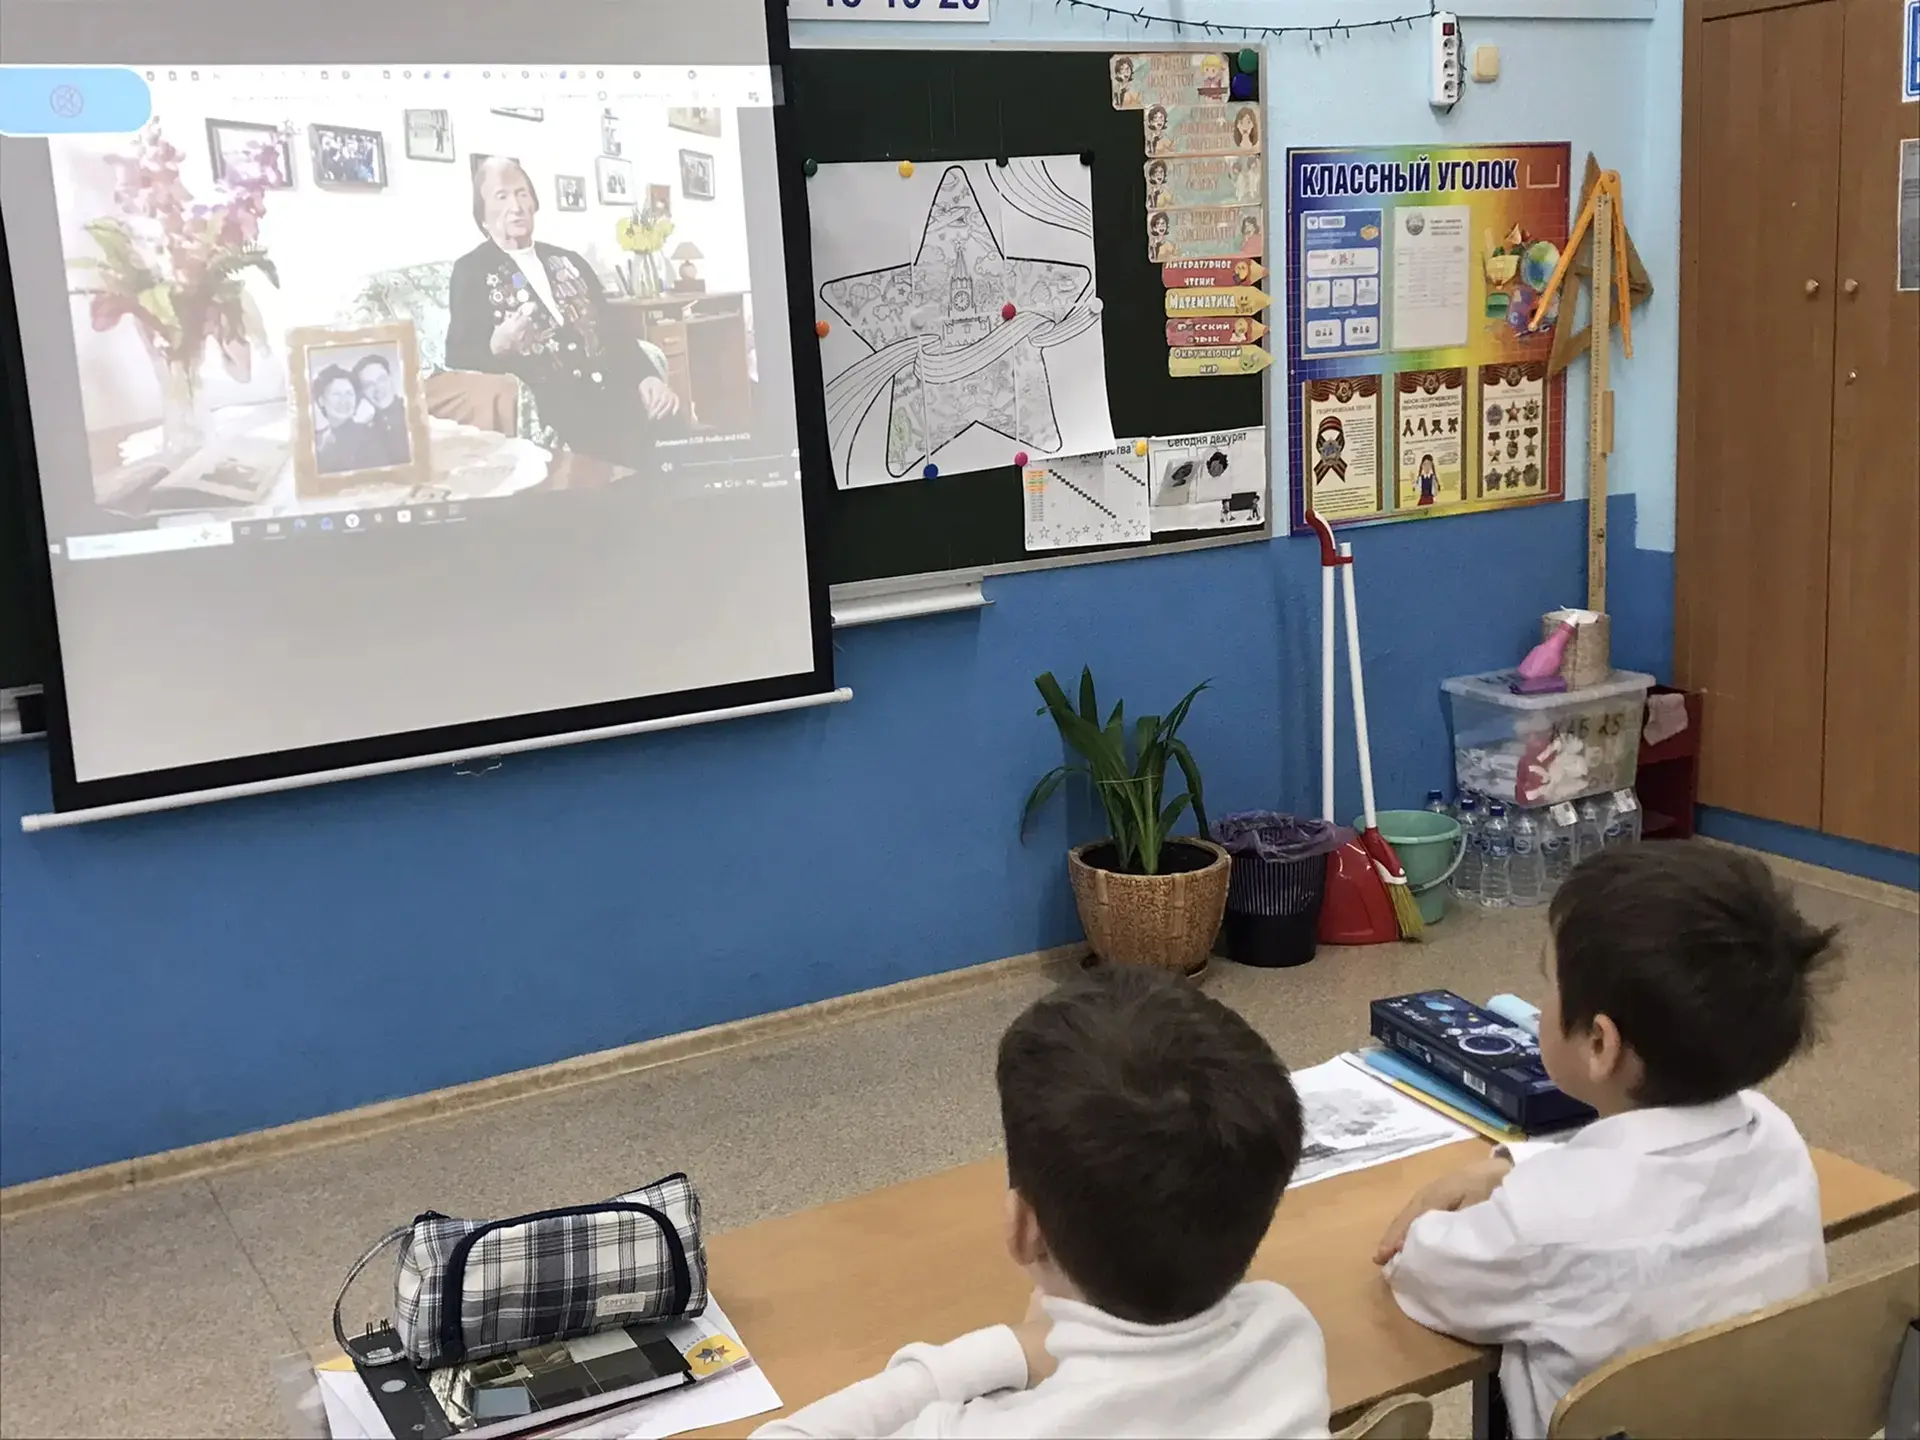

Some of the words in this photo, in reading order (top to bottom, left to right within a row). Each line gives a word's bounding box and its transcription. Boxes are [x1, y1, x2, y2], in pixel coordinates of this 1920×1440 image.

[1301, 155, 1431, 197] КЛАССНЫЙ
[1437, 160, 1518, 191] УГОЛОК
[1167, 437, 1208, 448] Сегодня
[1210, 432, 1247, 446] дежурят
